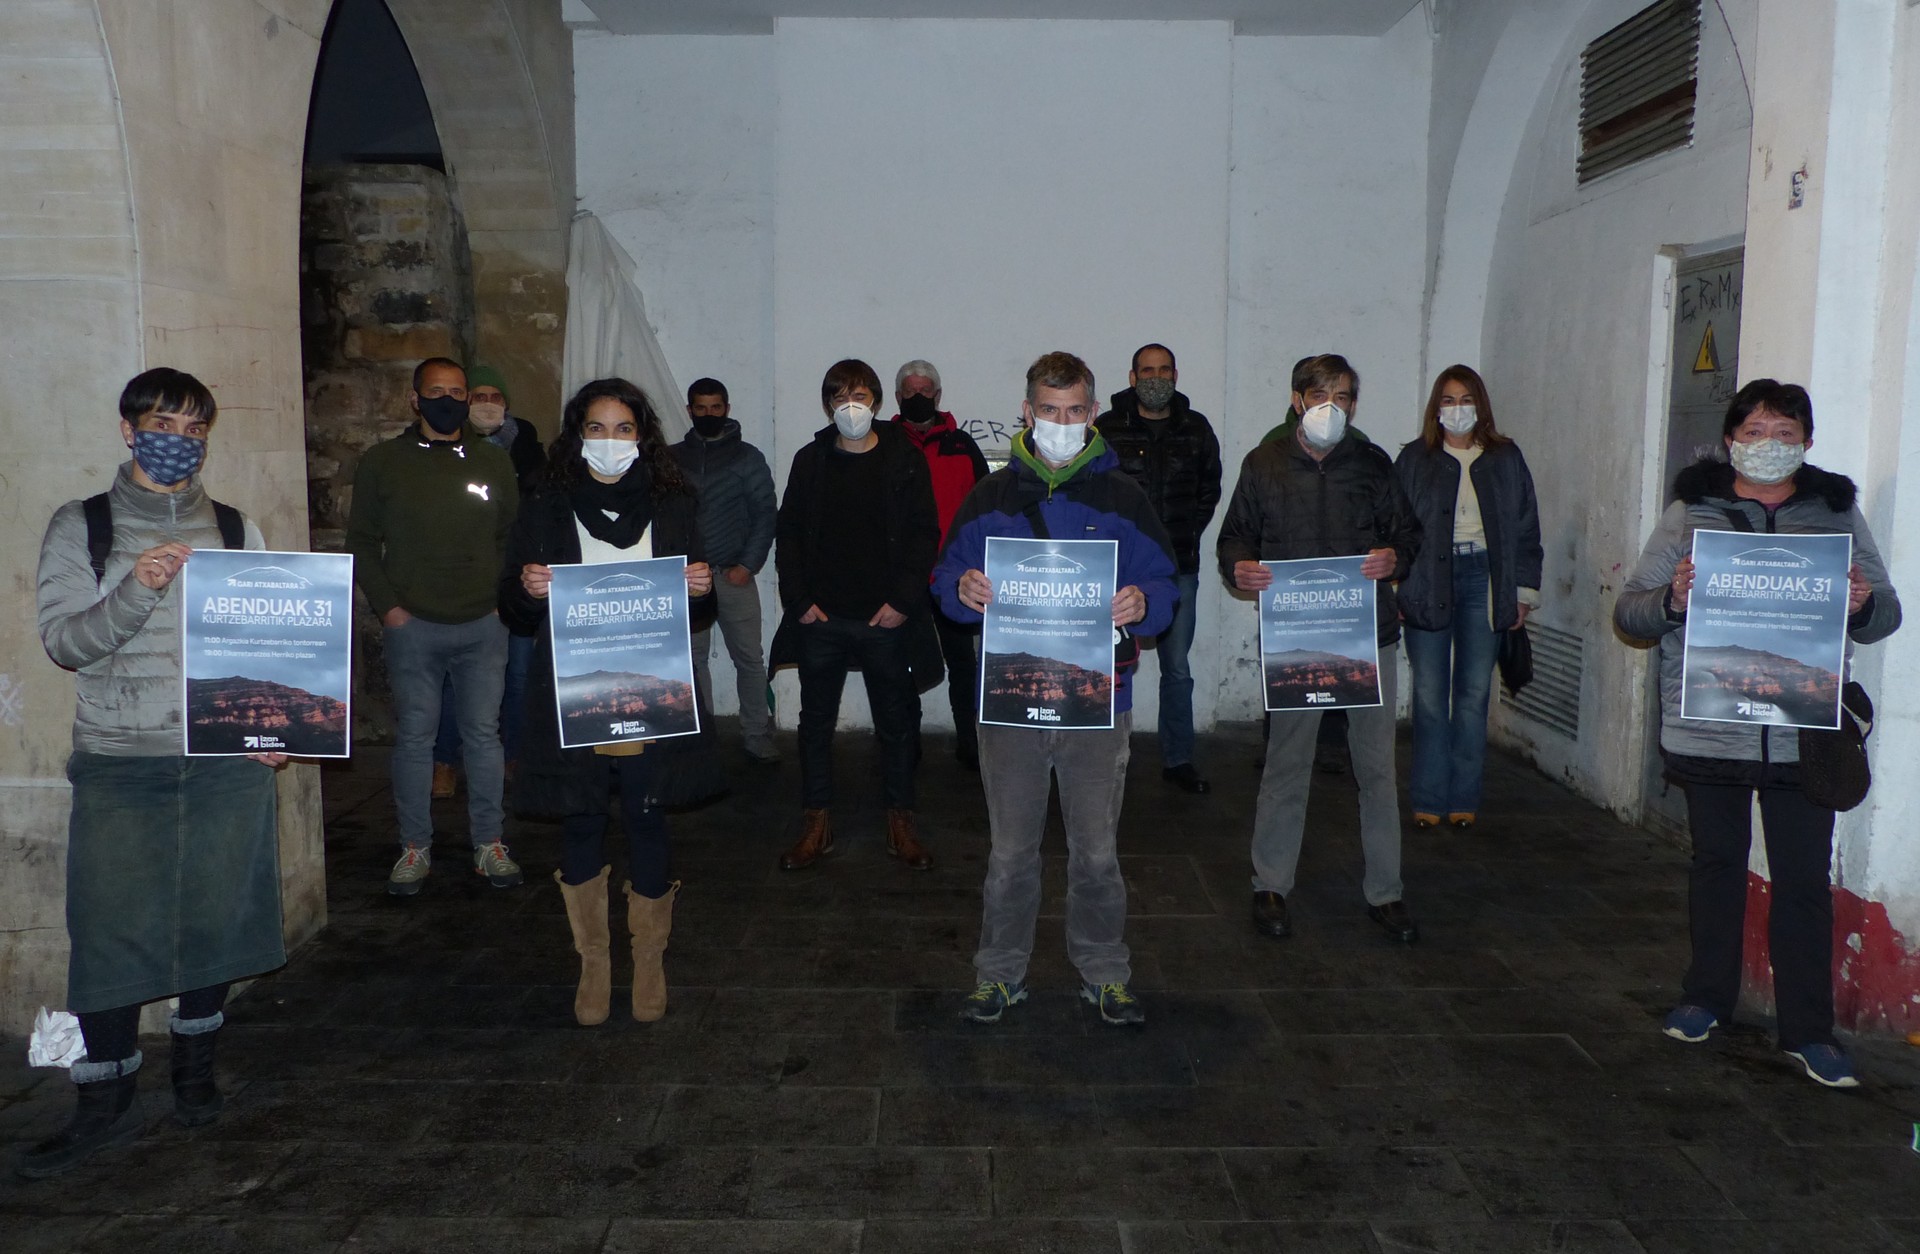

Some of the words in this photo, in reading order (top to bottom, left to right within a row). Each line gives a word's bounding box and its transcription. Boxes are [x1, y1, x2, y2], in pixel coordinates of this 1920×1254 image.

[999, 580, 1082, 598] ABENDUAK
[1087, 583, 1101, 598] 31
[1707, 573, 1808, 591] ABENDUAK
[1813, 578, 1831, 593] 31
[998, 596, 1063, 607] KURTZEBARRITIK
[1065, 599, 1101, 607] PLAZARA
[1273, 590, 1347, 604] ABENDUAK
[1349, 589, 1362, 600] 31
[1706, 590, 1783, 600] KURTZEBARRITIK
[1786, 592, 1830, 602] PLAZARA
[203, 597, 308, 616] ABENDUAK
[314, 600, 332, 616] 31
[567, 598, 654, 618] ABENDUAK
[657, 596, 672, 611] 31
[1272, 602, 1330, 612] KURTZEBARRITIK
[203, 614, 285, 625] KURTZEBARRITIK
[288, 616, 332, 626] PLAZARA
[566, 614, 634, 628] KURTZEBARRITIK
[636, 611, 673, 622] PLAZARA
[646, 643, 662, 651] plazan
